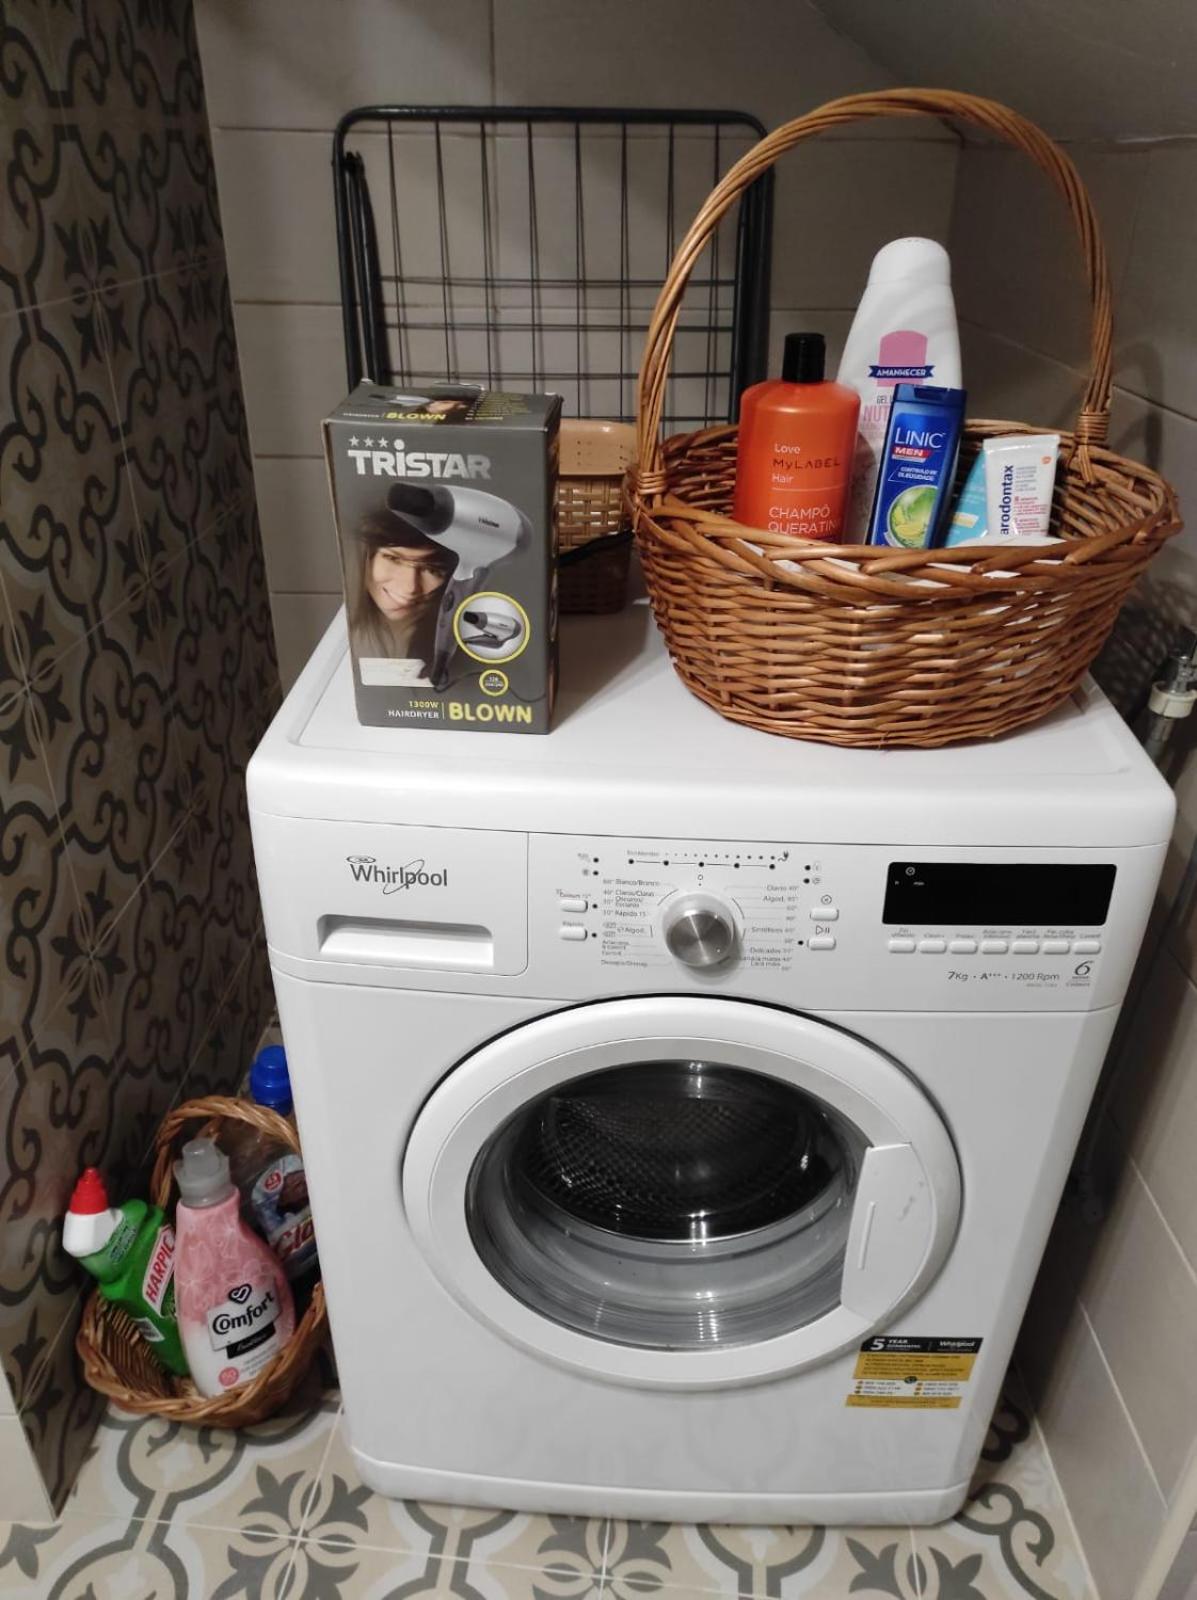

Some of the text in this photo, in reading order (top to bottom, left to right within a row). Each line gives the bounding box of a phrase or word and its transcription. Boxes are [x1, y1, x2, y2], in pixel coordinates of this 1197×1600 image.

[386, 412, 447, 421] BLOWN
[894, 427, 943, 448] LINIC
[774, 442, 801, 454] Love
[894, 446, 925, 457] MEN
[771, 472, 794, 483] Hair
[408, 700, 440, 709] 1300W
[388, 709, 441, 719] HAIRDRYER
[448, 702, 533, 724] BLOWN
[349, 861, 449, 890] Whirlpool
[1011, 973, 1035, 981] 1200
[1037, 973, 1060, 982] Rpm
[145, 1234, 175, 1304] HARPIC
[212, 1291, 275, 1335] Comfort
[870, 1338, 886, 1351] 5
